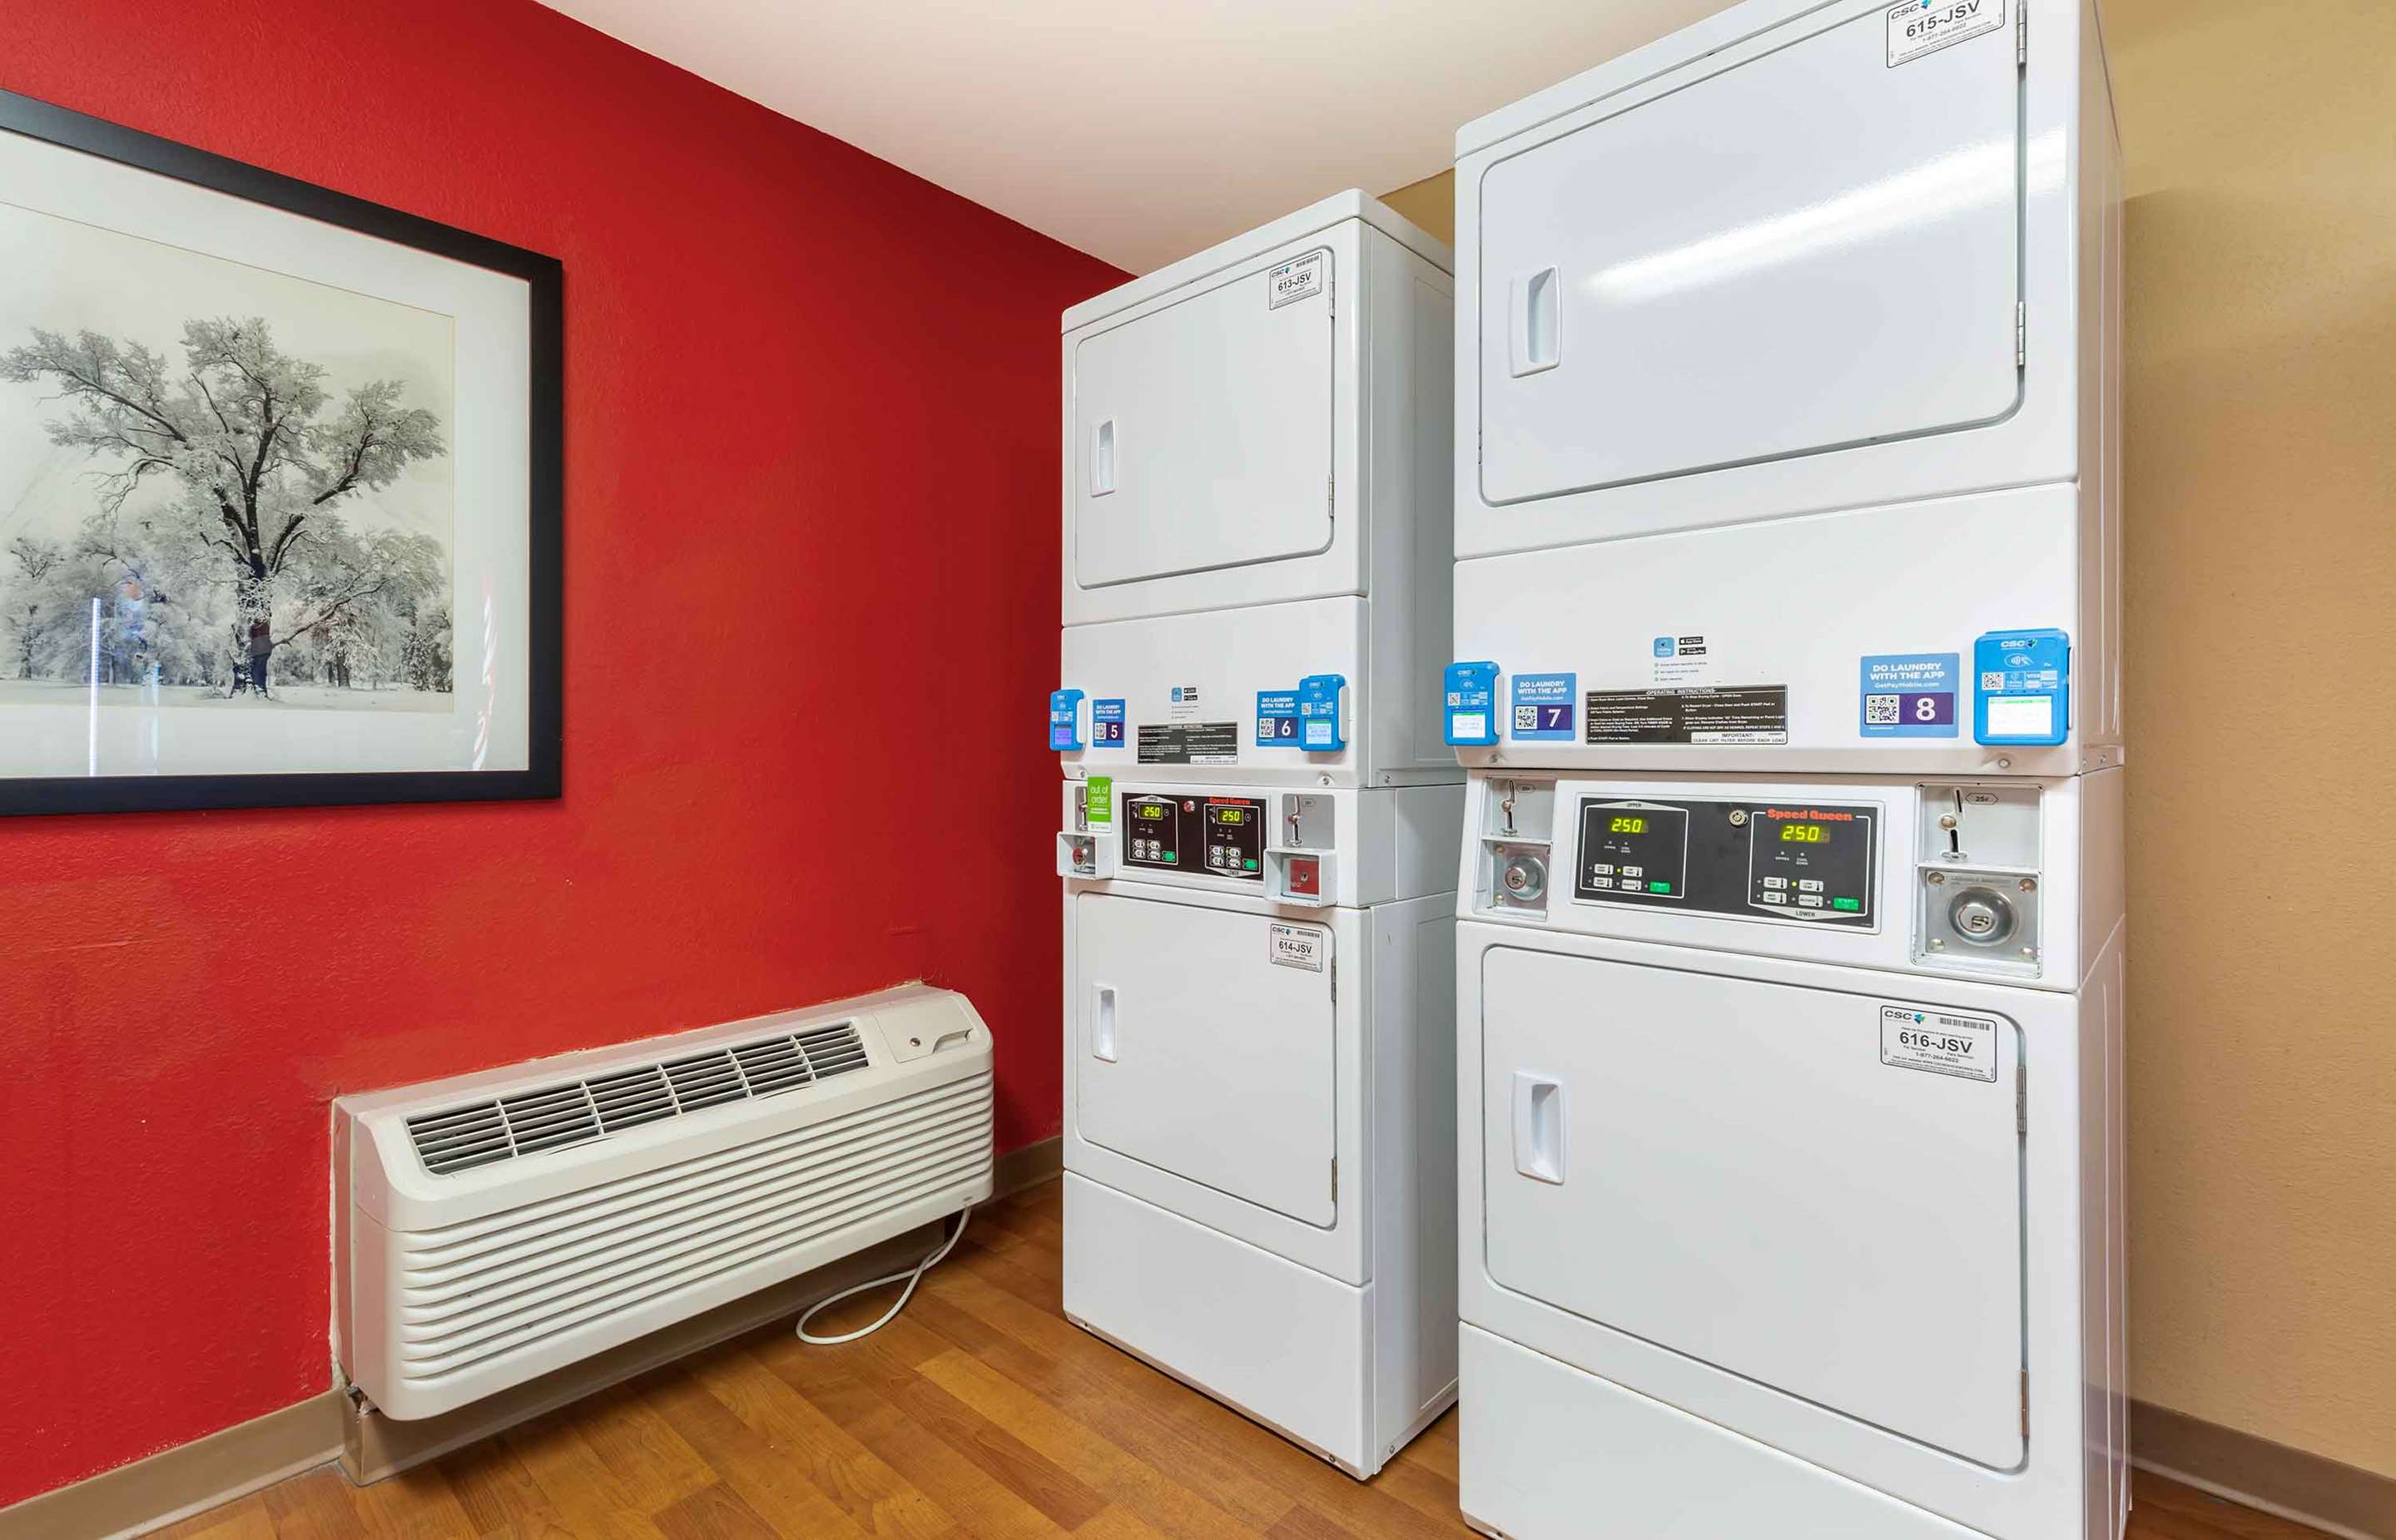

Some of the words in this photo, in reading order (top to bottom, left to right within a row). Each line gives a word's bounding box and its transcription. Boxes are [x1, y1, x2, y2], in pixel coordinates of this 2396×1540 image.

[1891, 3, 1919, 20] CSC
[1907, 0, 1979, 37] 615-JSV
[1278, 272, 1311, 290] 613-JSV
[1891, 662, 1942, 671] LAUNDRY
[1916, 698, 1936, 720] 8
[1548, 709, 1561, 727] 7
[1111, 725, 1118, 738] 5
[1282, 720, 1291, 736] 6
[1144, 806, 1160, 817] 250
[1223, 810, 1240, 822] 250
[1767, 809, 1808, 820] Speed
[1809, 810, 1853, 821] Queen
[1611, 819, 1642, 833] 250
[1782, 825, 1819, 840] 250
[1279, 941, 1312, 953] 614-JSV
[1884, 1010, 1912, 1020] CSC
[1900, 1032, 1972, 1053] 616-JSV
